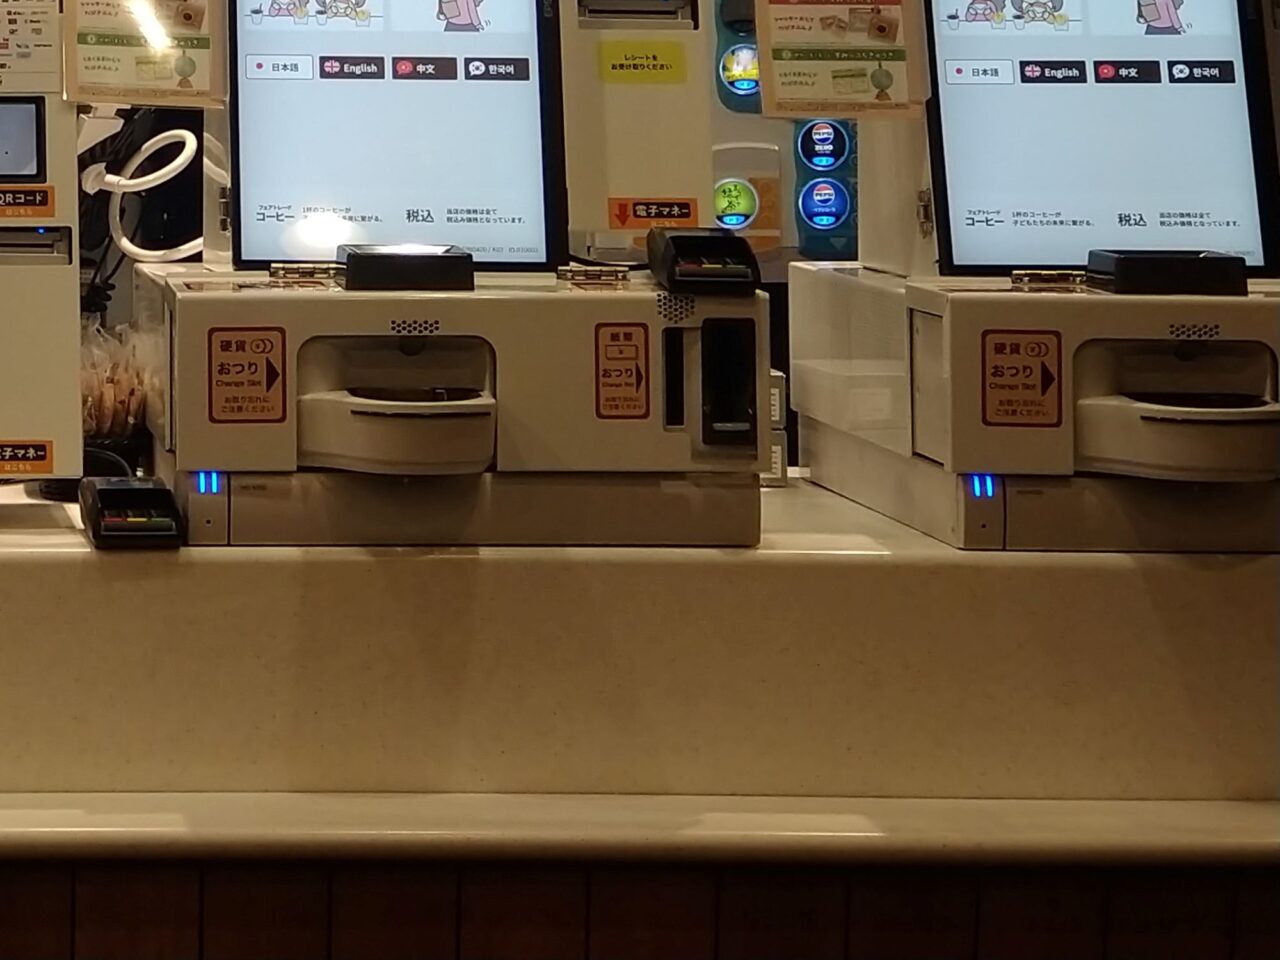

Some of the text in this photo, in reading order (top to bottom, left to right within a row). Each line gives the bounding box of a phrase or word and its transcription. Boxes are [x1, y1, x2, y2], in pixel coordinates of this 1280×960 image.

[271, 62, 300, 73] 日本語
[343, 62, 378, 75] English
[416, 63, 436, 74] 中文
[487, 63, 515, 75] 한국어
[971, 67, 1000, 78] 日本語
[1044, 67, 1080, 80] English
[1118, 67, 1139, 79] 中文
[1192, 67, 1220, 79] 한국어
[256, 211, 295, 223] コーヒー
[405, 209, 435, 223] 税込
[635, 205, 690, 217] 電子マネー
[965, 216, 1005, 227] コーヒー
[1117, 212, 1148, 227] 税込
[217, 360, 258, 376] おつり
[601, 368, 634, 379] おつり
[990, 363, 1034, 379] おつり
